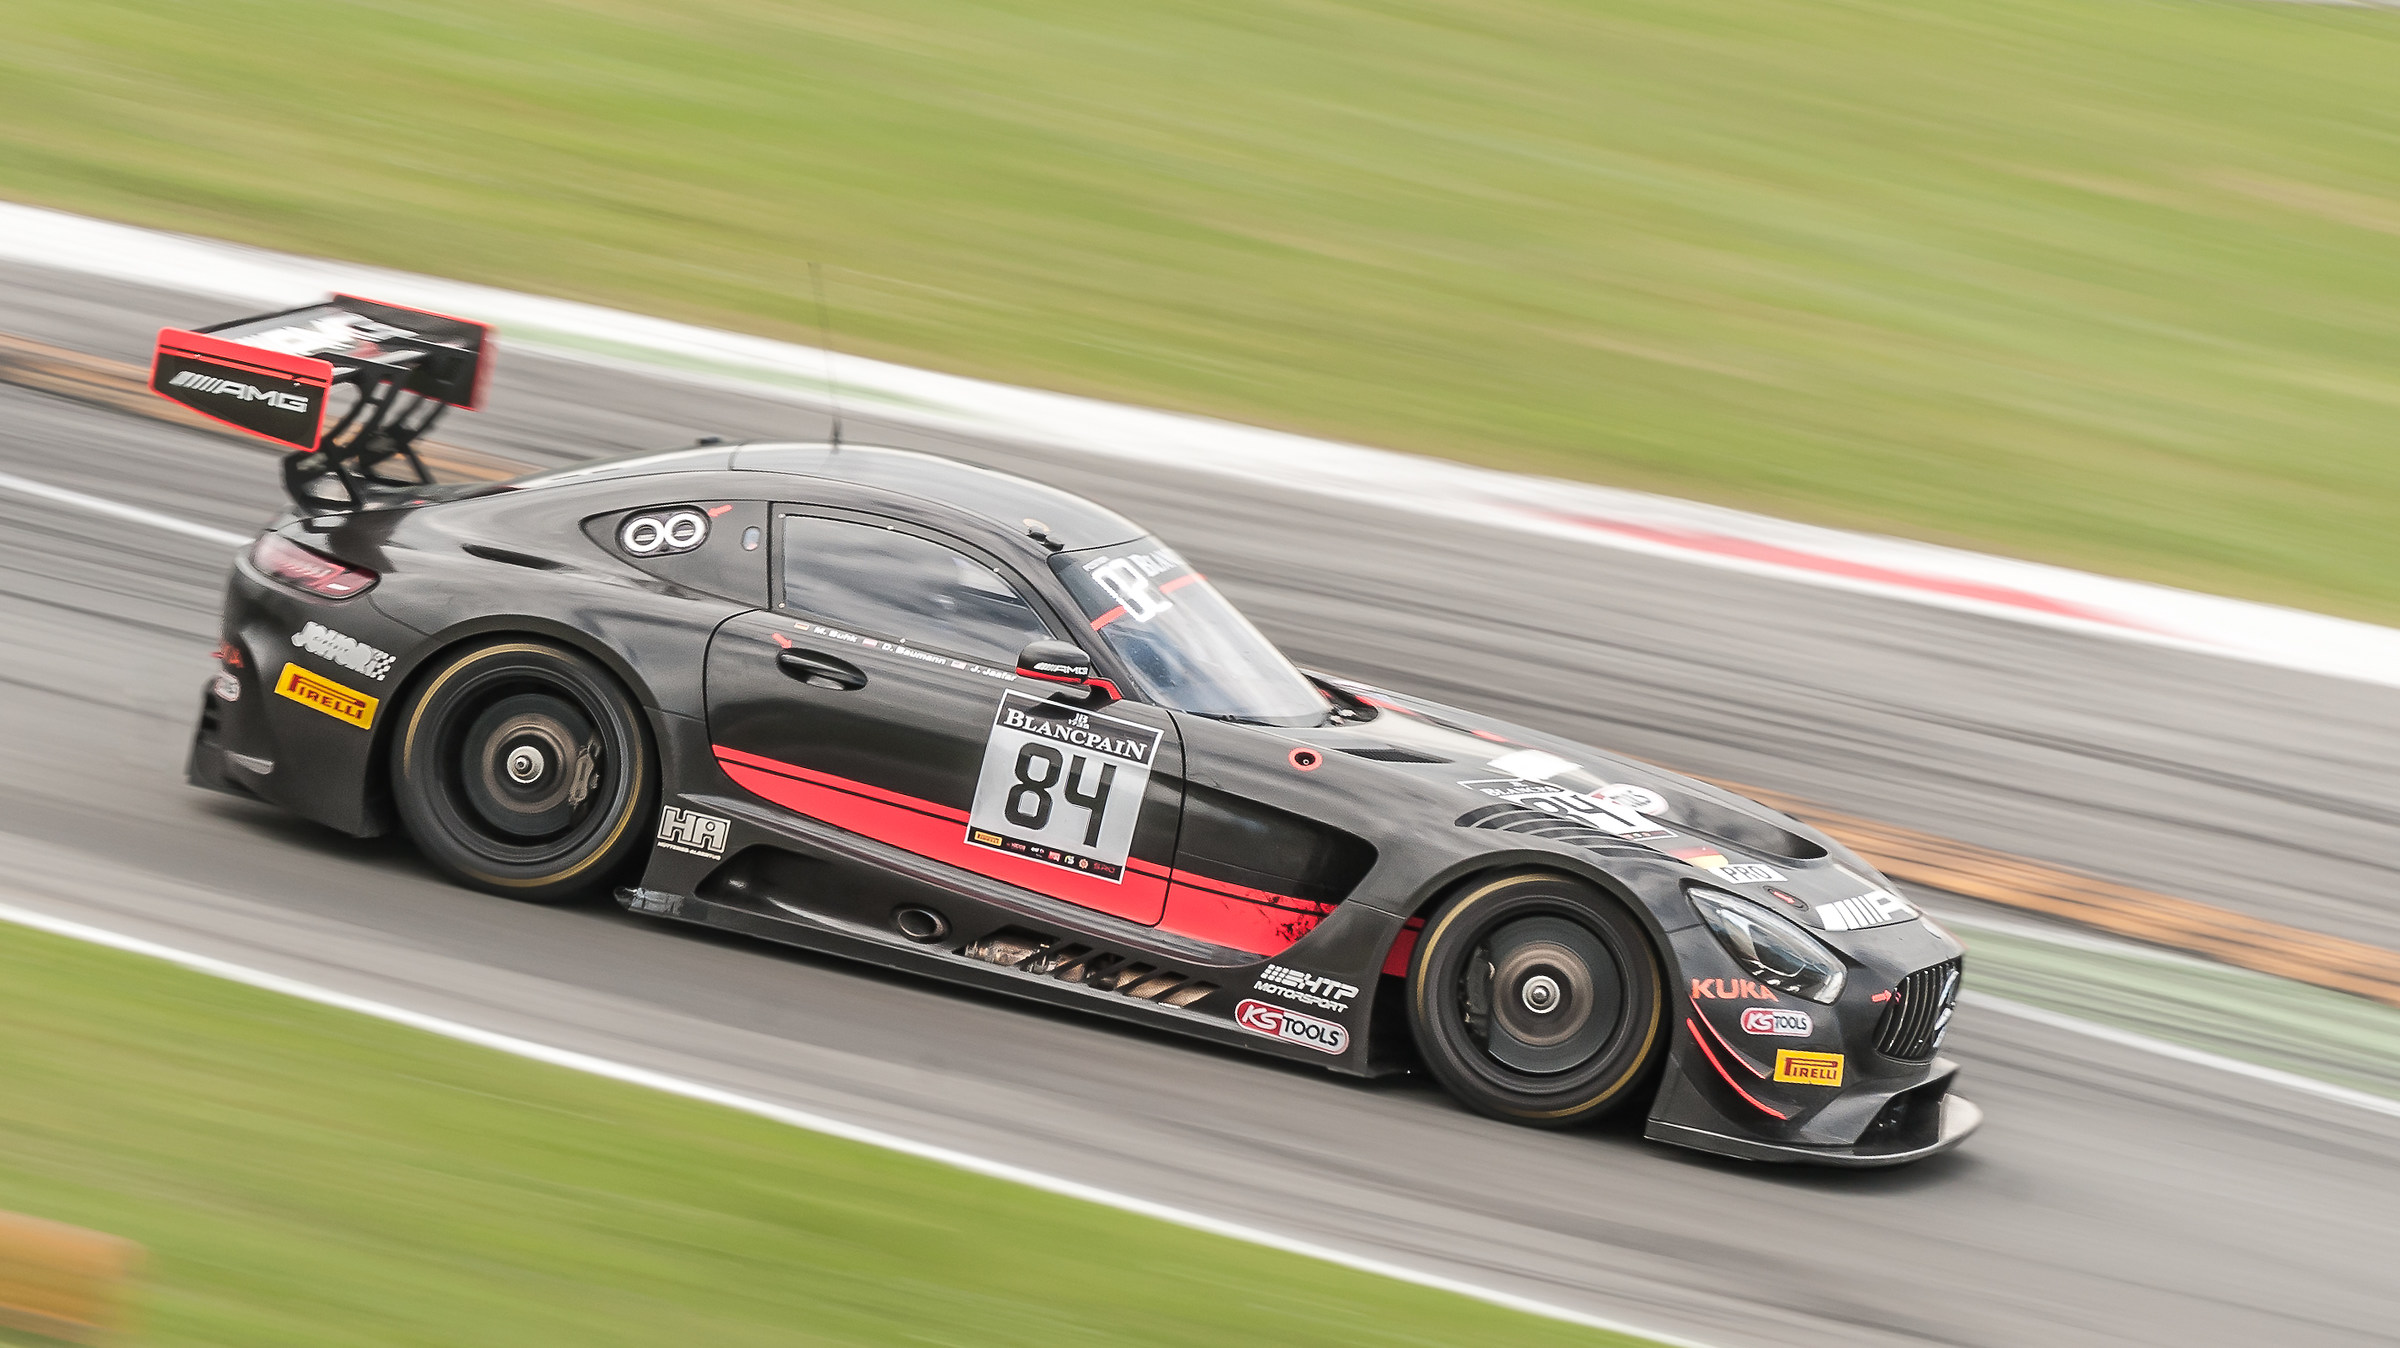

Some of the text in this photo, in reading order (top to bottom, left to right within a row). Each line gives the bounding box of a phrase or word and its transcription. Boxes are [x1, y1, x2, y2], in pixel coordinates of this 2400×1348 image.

[215, 379, 309, 414] AMG
[881, 642, 894, 653] D.
[969, 664, 981, 674] J.
[1053, 664, 1089, 676] AMG
[287, 673, 367, 720] PIRELLI
[1003, 707, 1149, 761] BLANCPAIN
[1004, 741, 1118, 849] 84
[1720, 865, 1773, 881] PRO
[1253, 980, 1349, 1013] MOTORSPORT
[1691, 977, 1779, 1002] KUKA
[1241, 1004, 1340, 1047] KS TOOLS
[1746, 1012, 1807, 1031] KS TOOLS
[1784, 1057, 1839, 1080] PIRELLI
